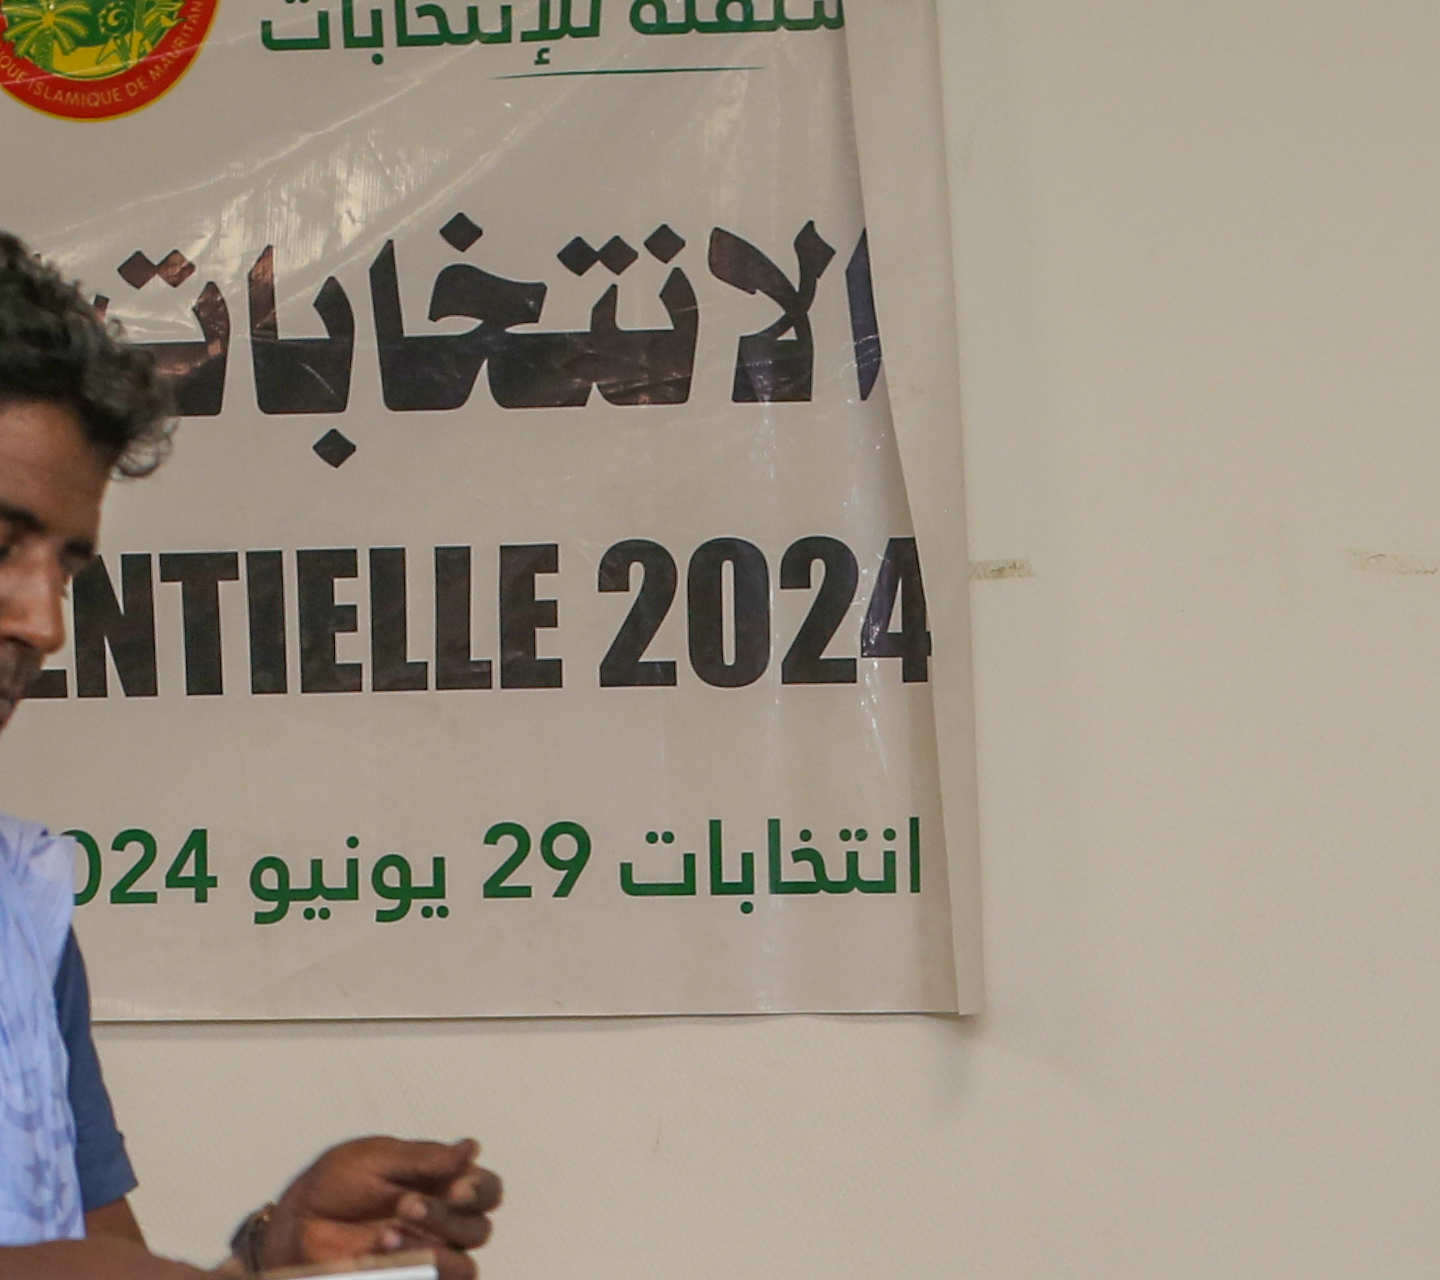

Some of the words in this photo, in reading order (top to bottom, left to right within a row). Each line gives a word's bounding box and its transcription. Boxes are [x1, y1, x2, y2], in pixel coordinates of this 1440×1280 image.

[27, 79, 123, 108] ISLAMIQUE
[124, 77, 149, 98] DE
[597, 536, 934, 688] 2024
[61, 828, 218, 906] 024
[250, 834, 450, 924] يونيو
[483, 820, 591, 898] 29
[620, 817, 921, 914] انتخابات
